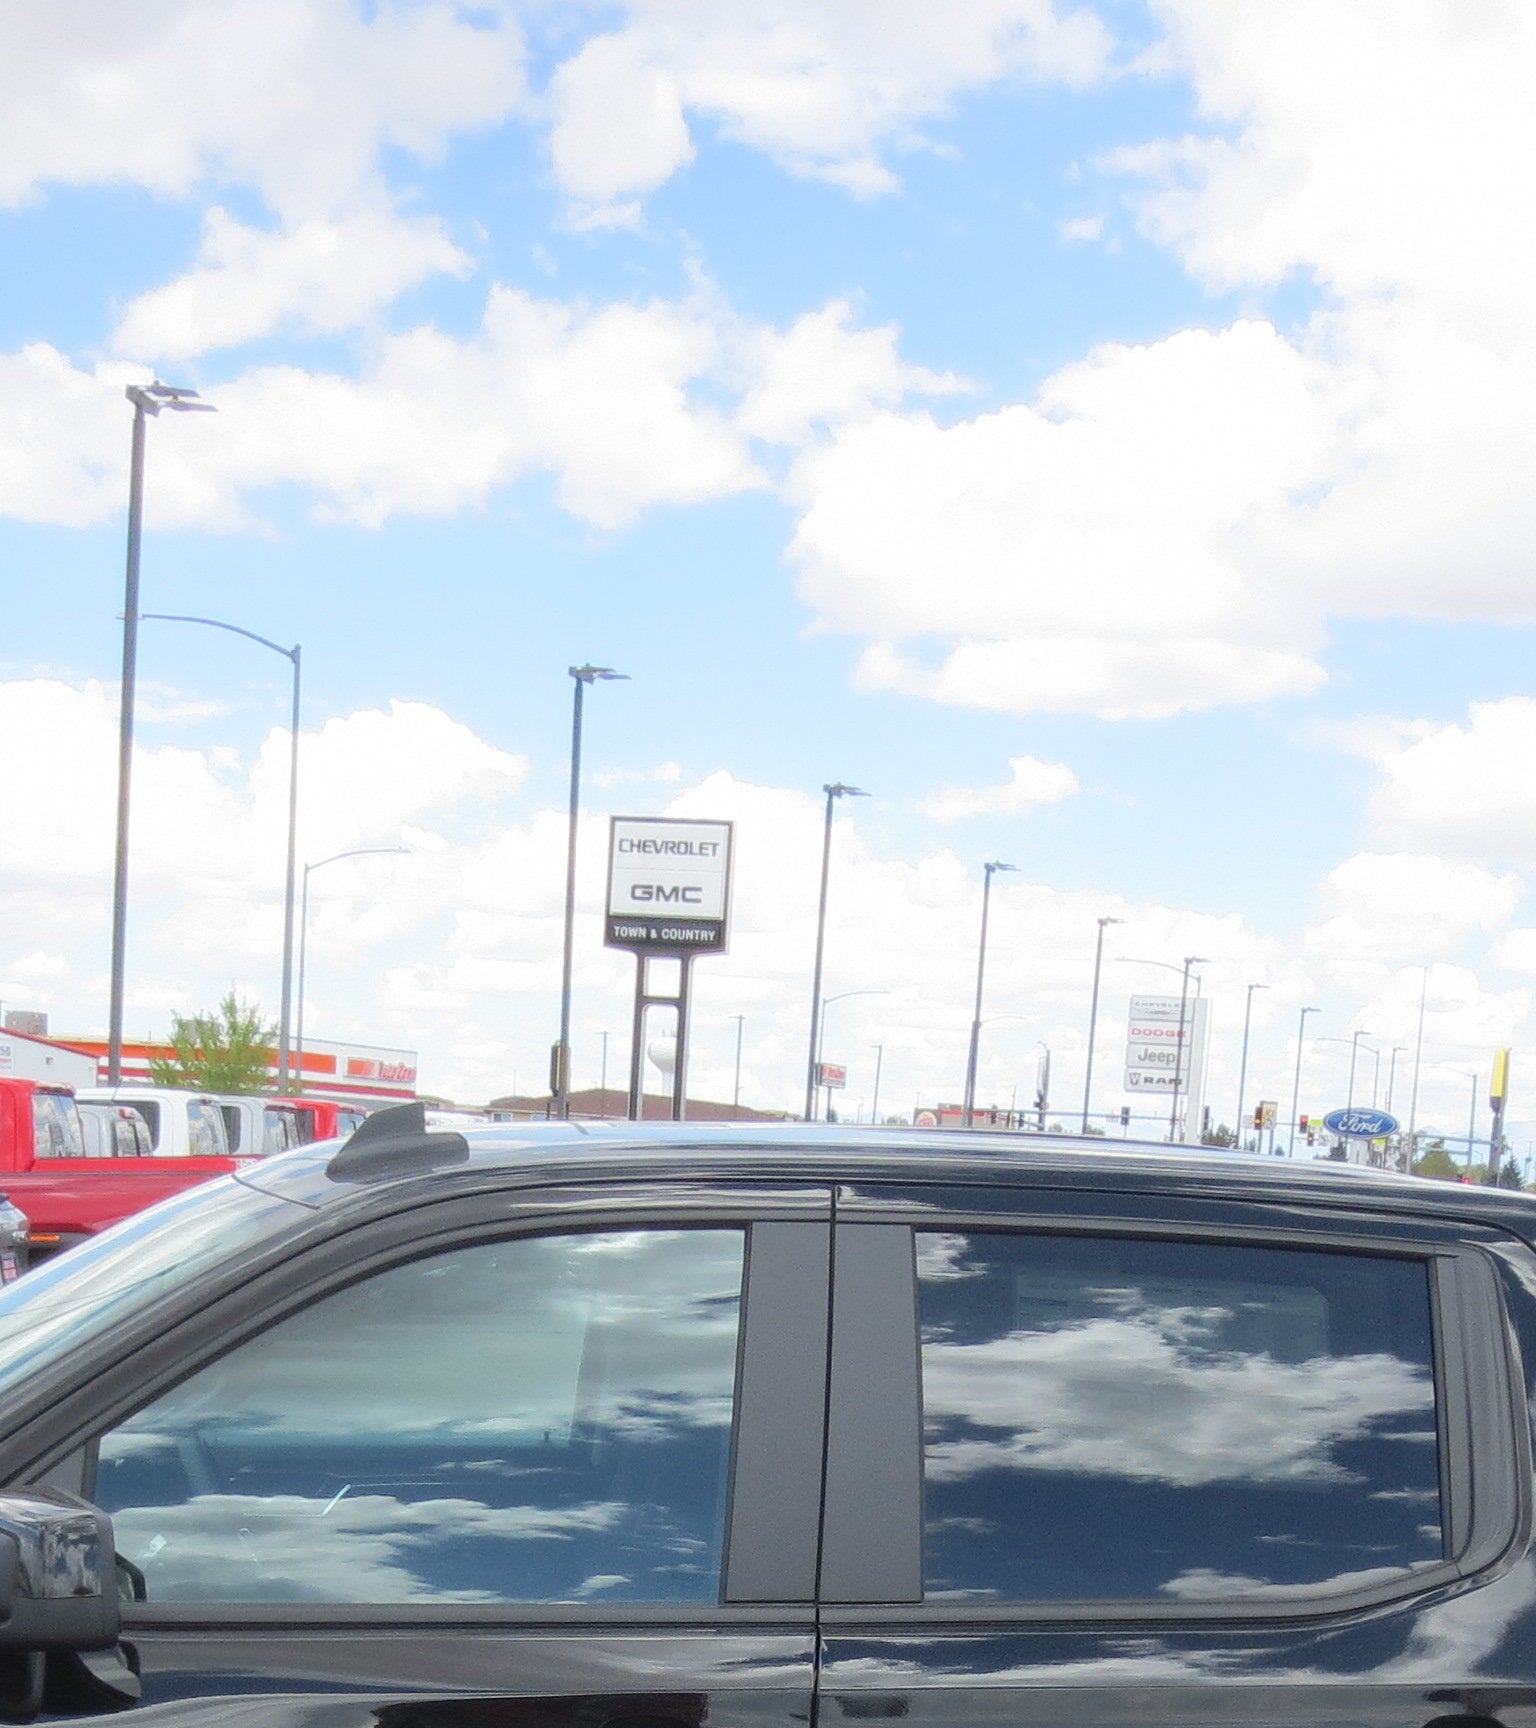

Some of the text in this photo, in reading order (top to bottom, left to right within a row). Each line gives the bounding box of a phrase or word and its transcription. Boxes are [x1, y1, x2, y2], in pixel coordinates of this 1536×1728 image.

[618, 837, 721, 857] CHEVROLET
[630, 884, 703, 904] GMC
[614, 925, 716, 942] TOWN & COUNTRY
[1137, 1048, 1176, 1066] Jeep
[1143, 1076, 1183, 1085] RAM
[1337, 1112, 1382, 1134] Ford
